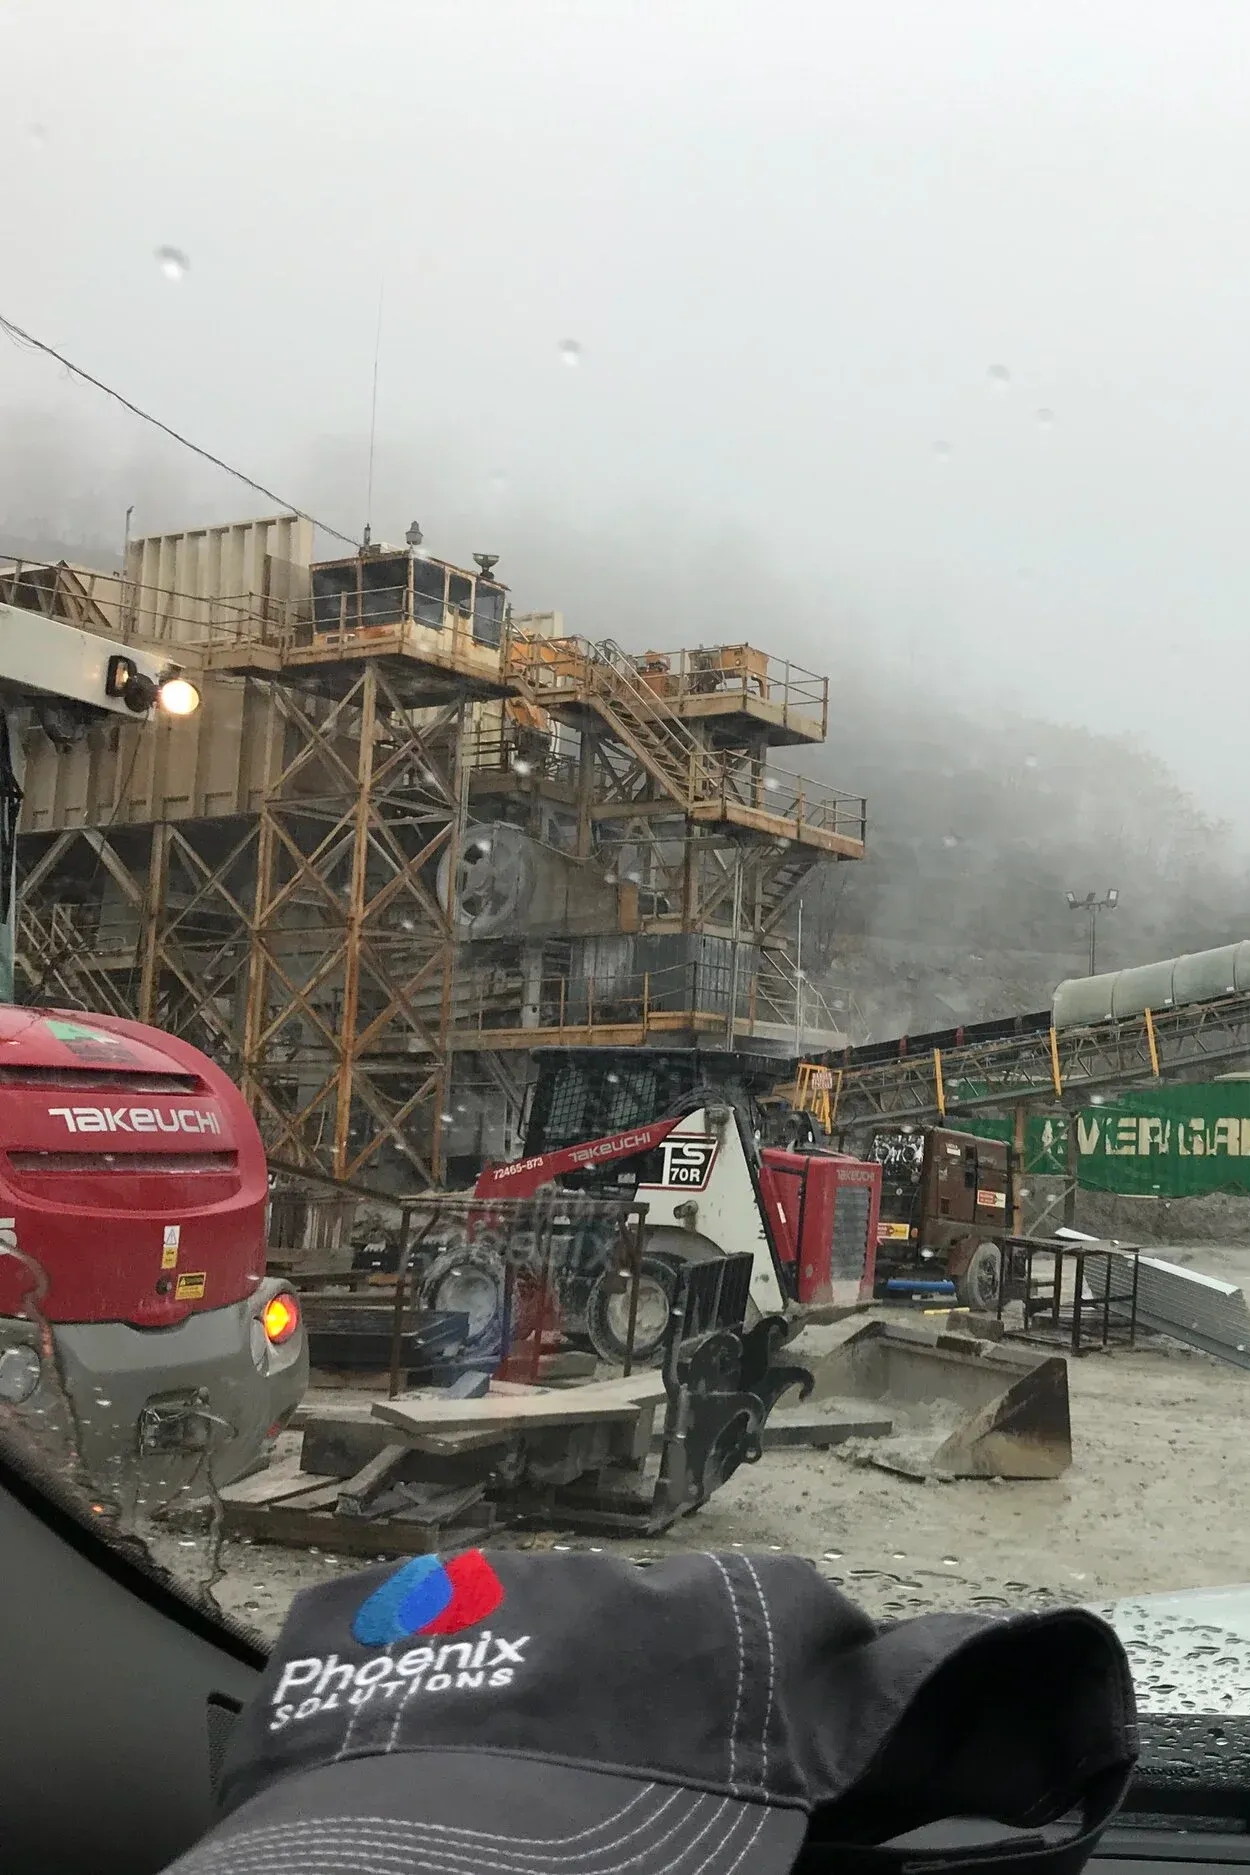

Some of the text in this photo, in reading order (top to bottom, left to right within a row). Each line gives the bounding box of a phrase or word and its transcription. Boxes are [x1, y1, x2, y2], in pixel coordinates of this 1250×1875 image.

[47, 1107, 221, 1135] TAKEUCHI
[567, 1132, 651, 1163] TAKEUCHI
[493, 1157, 544, 1181] 72465-873
[658, 1141, 706, 1186] TS
[670, 1167, 700, 1183] 70R
[271, 1630, 531, 1705] Phoenix
[270, 1667, 514, 1730] SOLUTIONS
